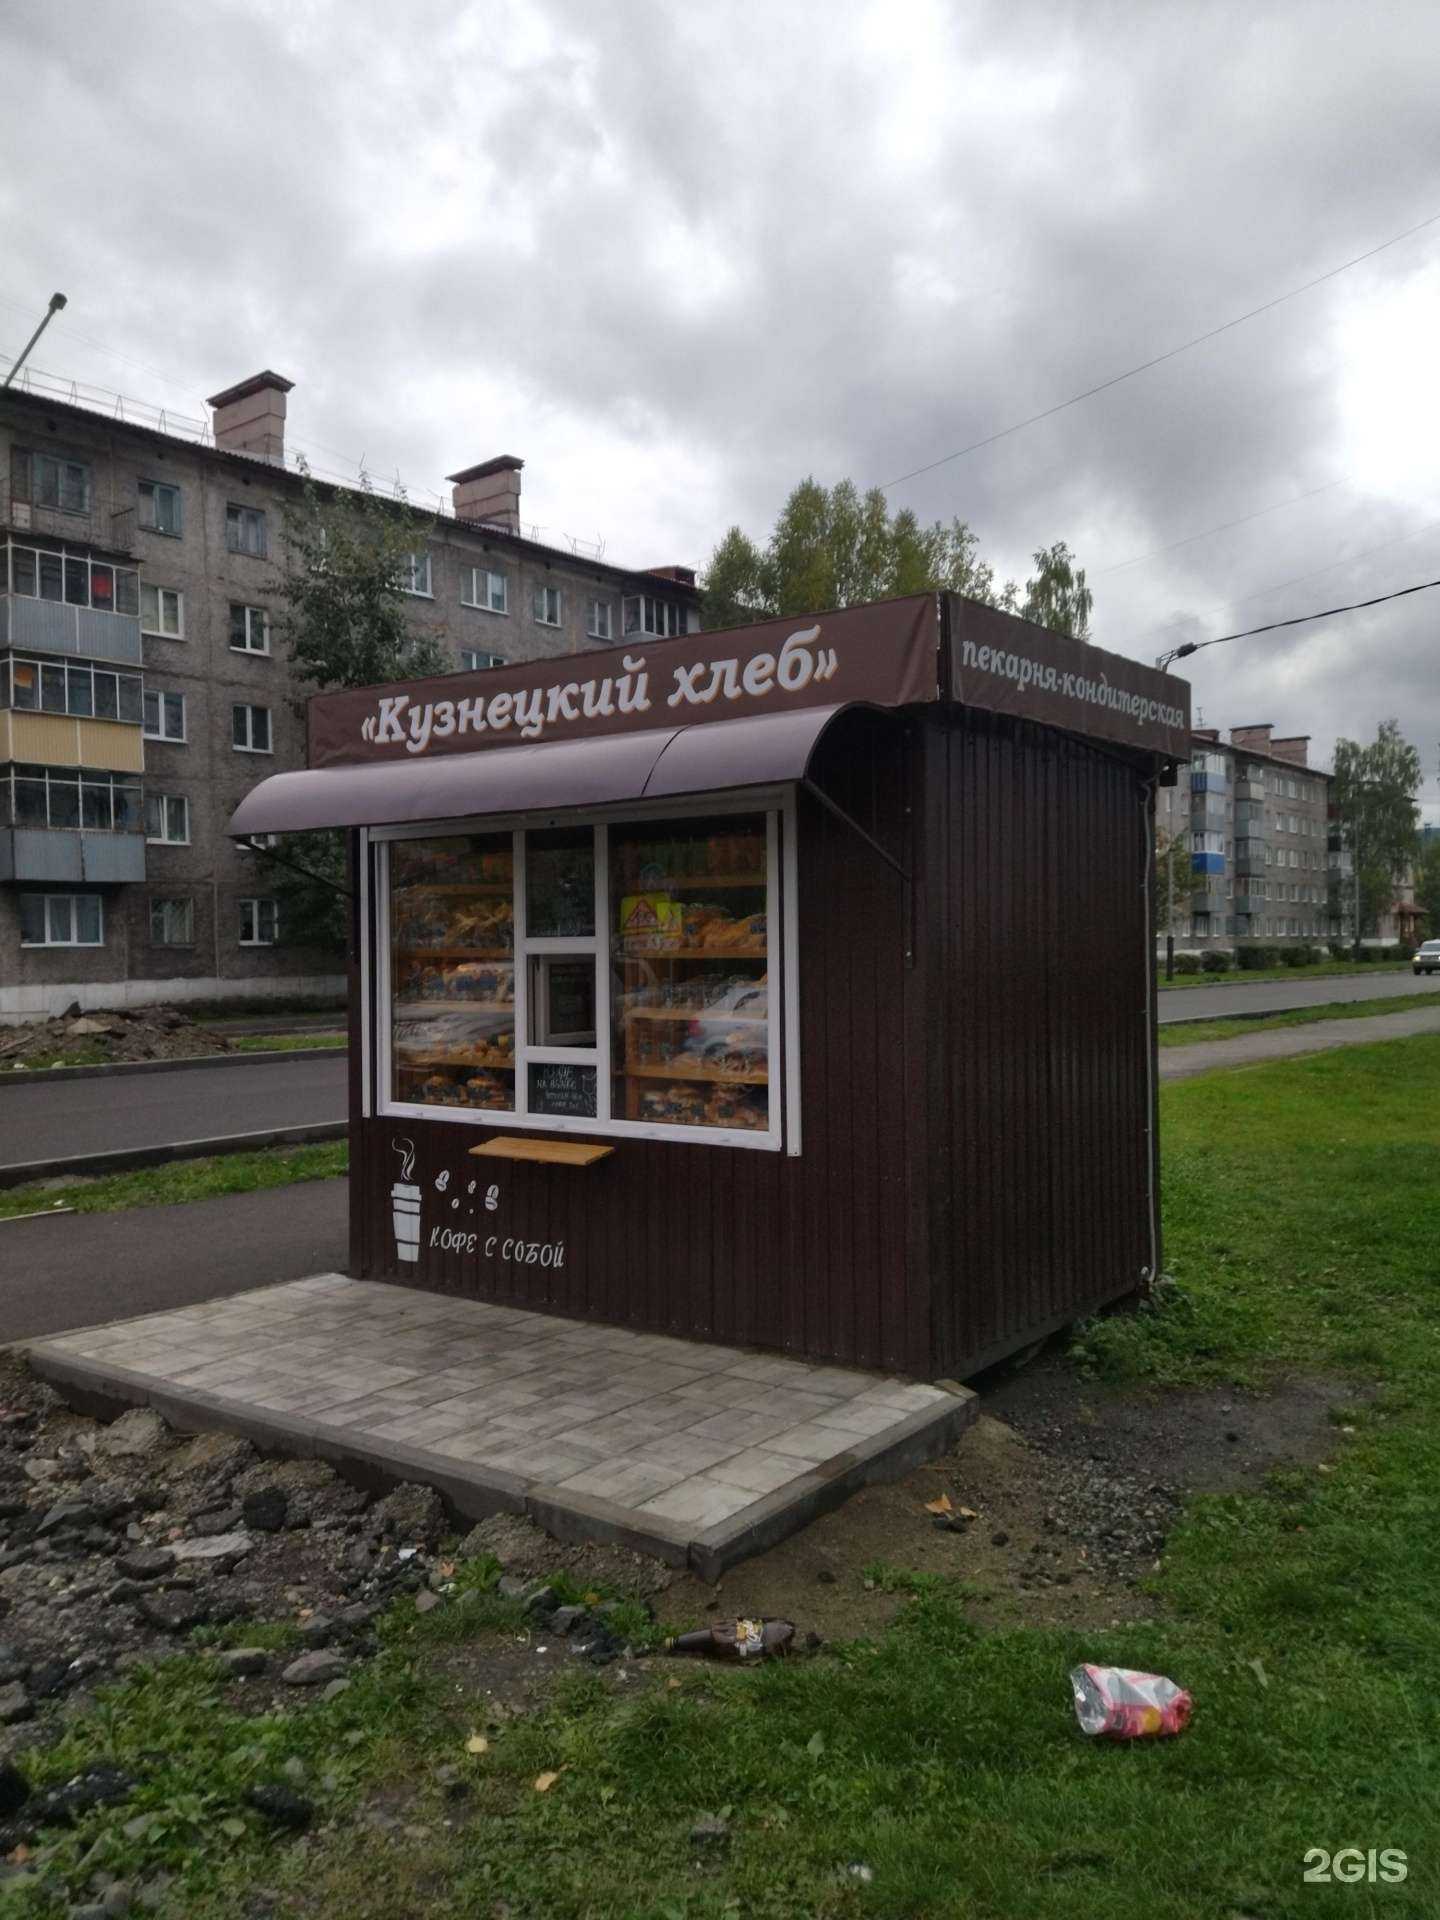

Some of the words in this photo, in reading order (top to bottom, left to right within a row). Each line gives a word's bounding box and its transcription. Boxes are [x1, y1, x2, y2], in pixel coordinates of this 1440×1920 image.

[361, 655, 652, 754] «Кузнецкий
[667, 624, 839, 708] хлеб»
[962, 639, 1185, 729] пекарня-кондитерская
[429, 1226, 477, 1254] КОФЕ
[502, 1238, 565, 1268] СОБОЙ
